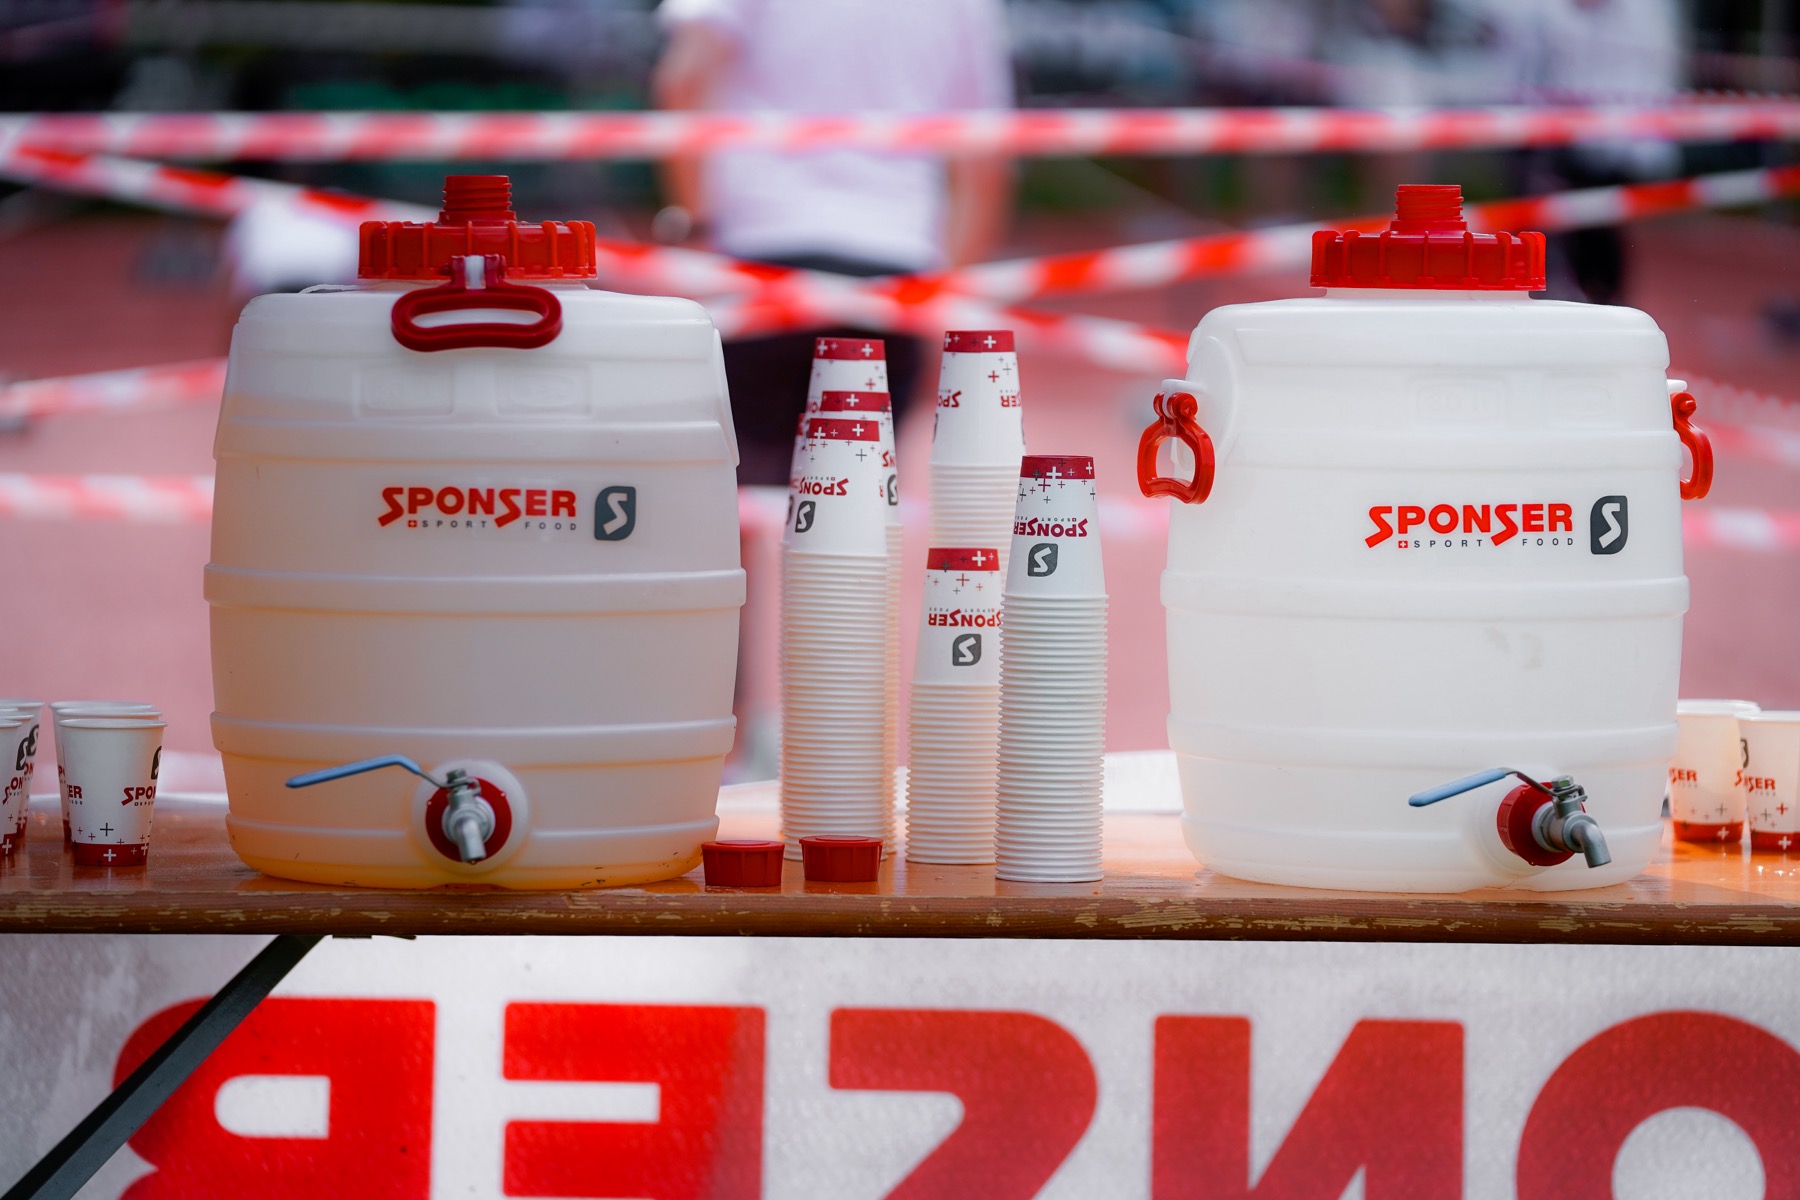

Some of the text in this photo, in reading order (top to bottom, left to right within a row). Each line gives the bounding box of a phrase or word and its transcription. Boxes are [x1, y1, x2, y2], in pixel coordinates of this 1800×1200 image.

[378, 486, 577, 528] SPONSER
[421, 520, 577, 531] SPORT FOOD
[600, 490, 631, 537] S
[1013, 517, 1088, 538] SPONSER
[1364, 503, 1573, 549] SPONSER
[1596, 500, 1624, 551] S
[1413, 537, 1574, 548] SPORT FOOD
